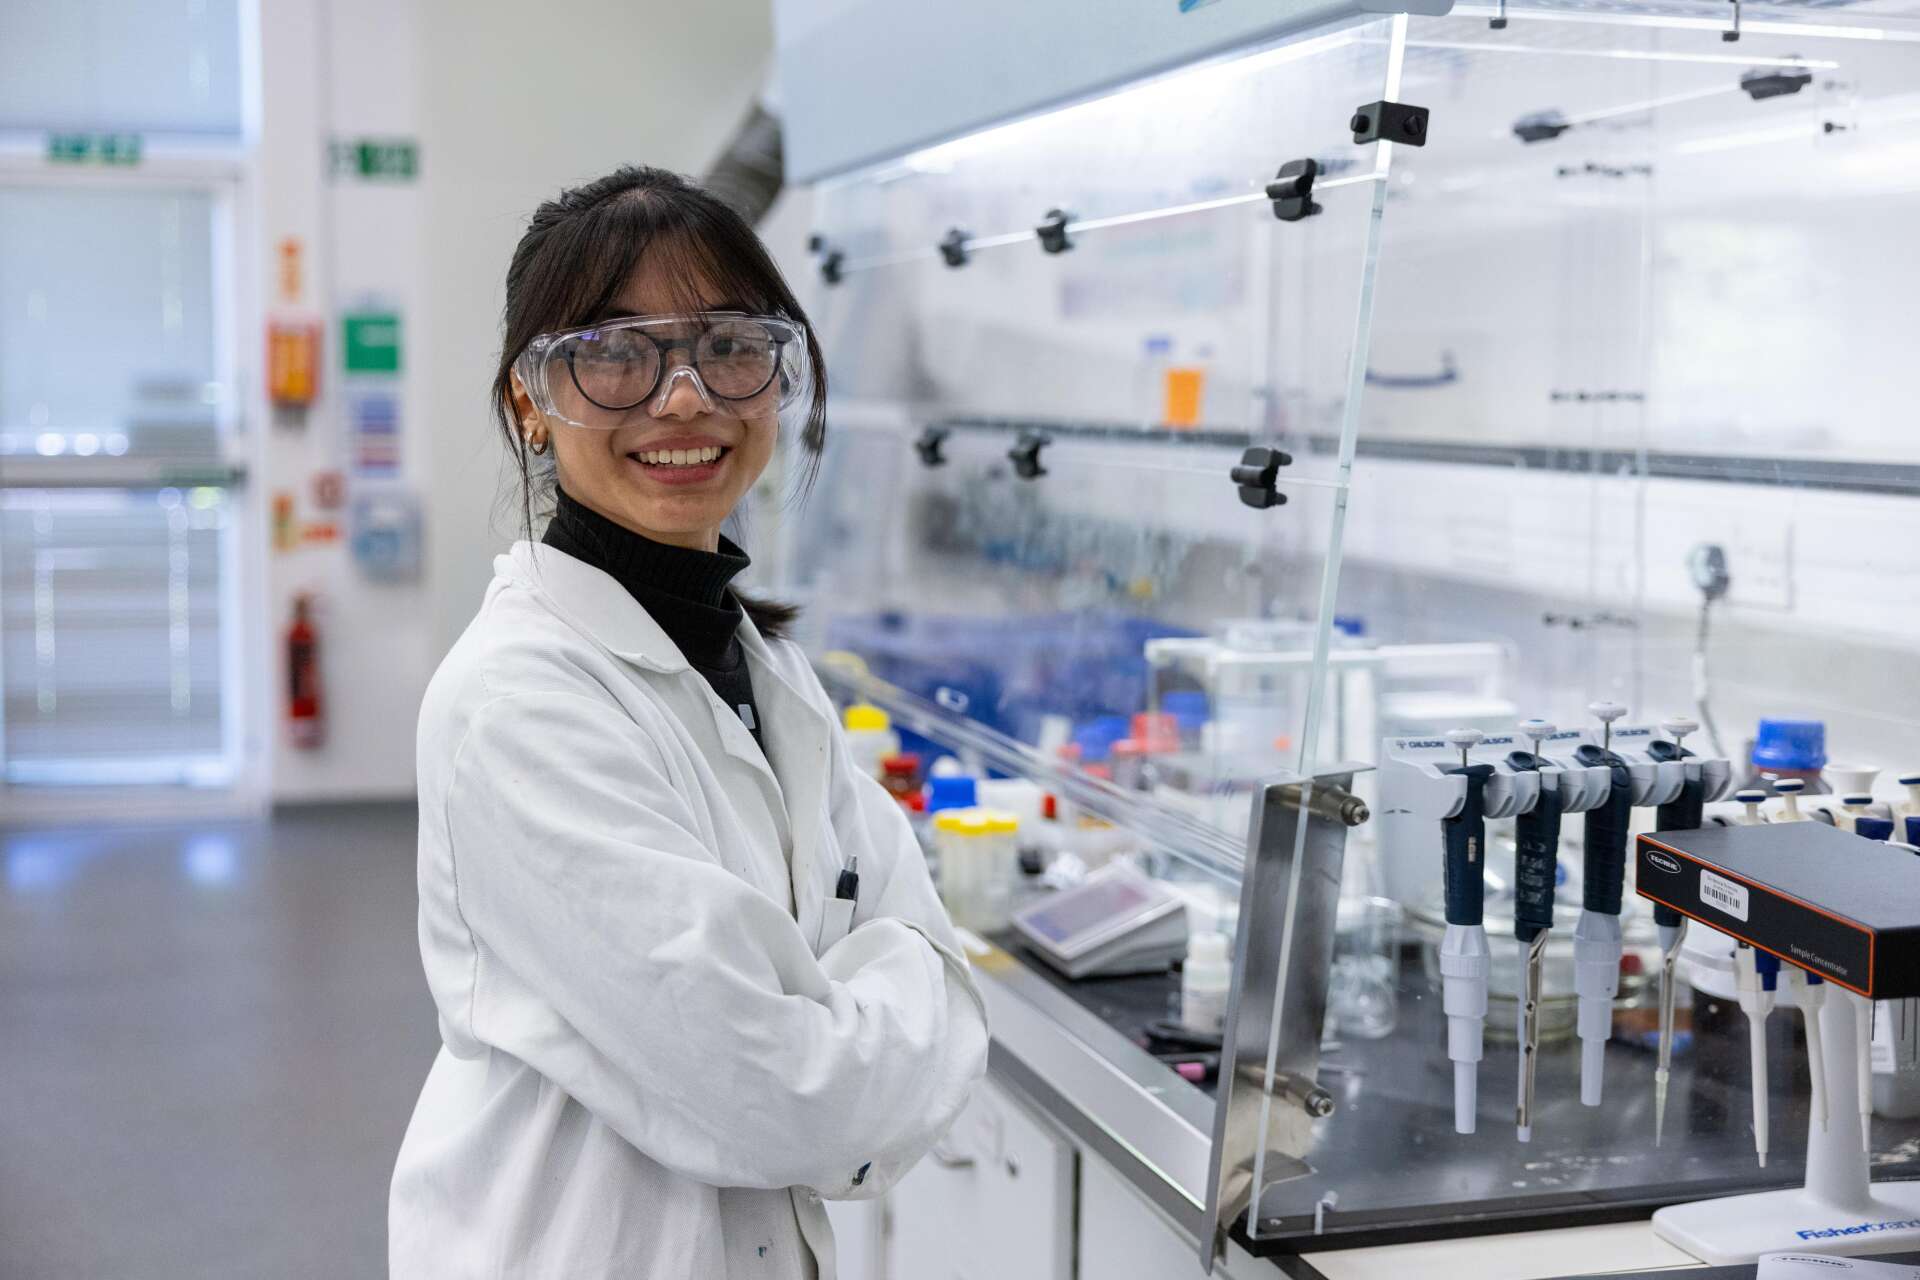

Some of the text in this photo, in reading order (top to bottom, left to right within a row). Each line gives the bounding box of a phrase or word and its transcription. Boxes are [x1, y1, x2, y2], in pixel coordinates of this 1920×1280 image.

[1650, 854, 1678, 871] TECHNE
[1790, 943, 1848, 976] Sample Concentrator
